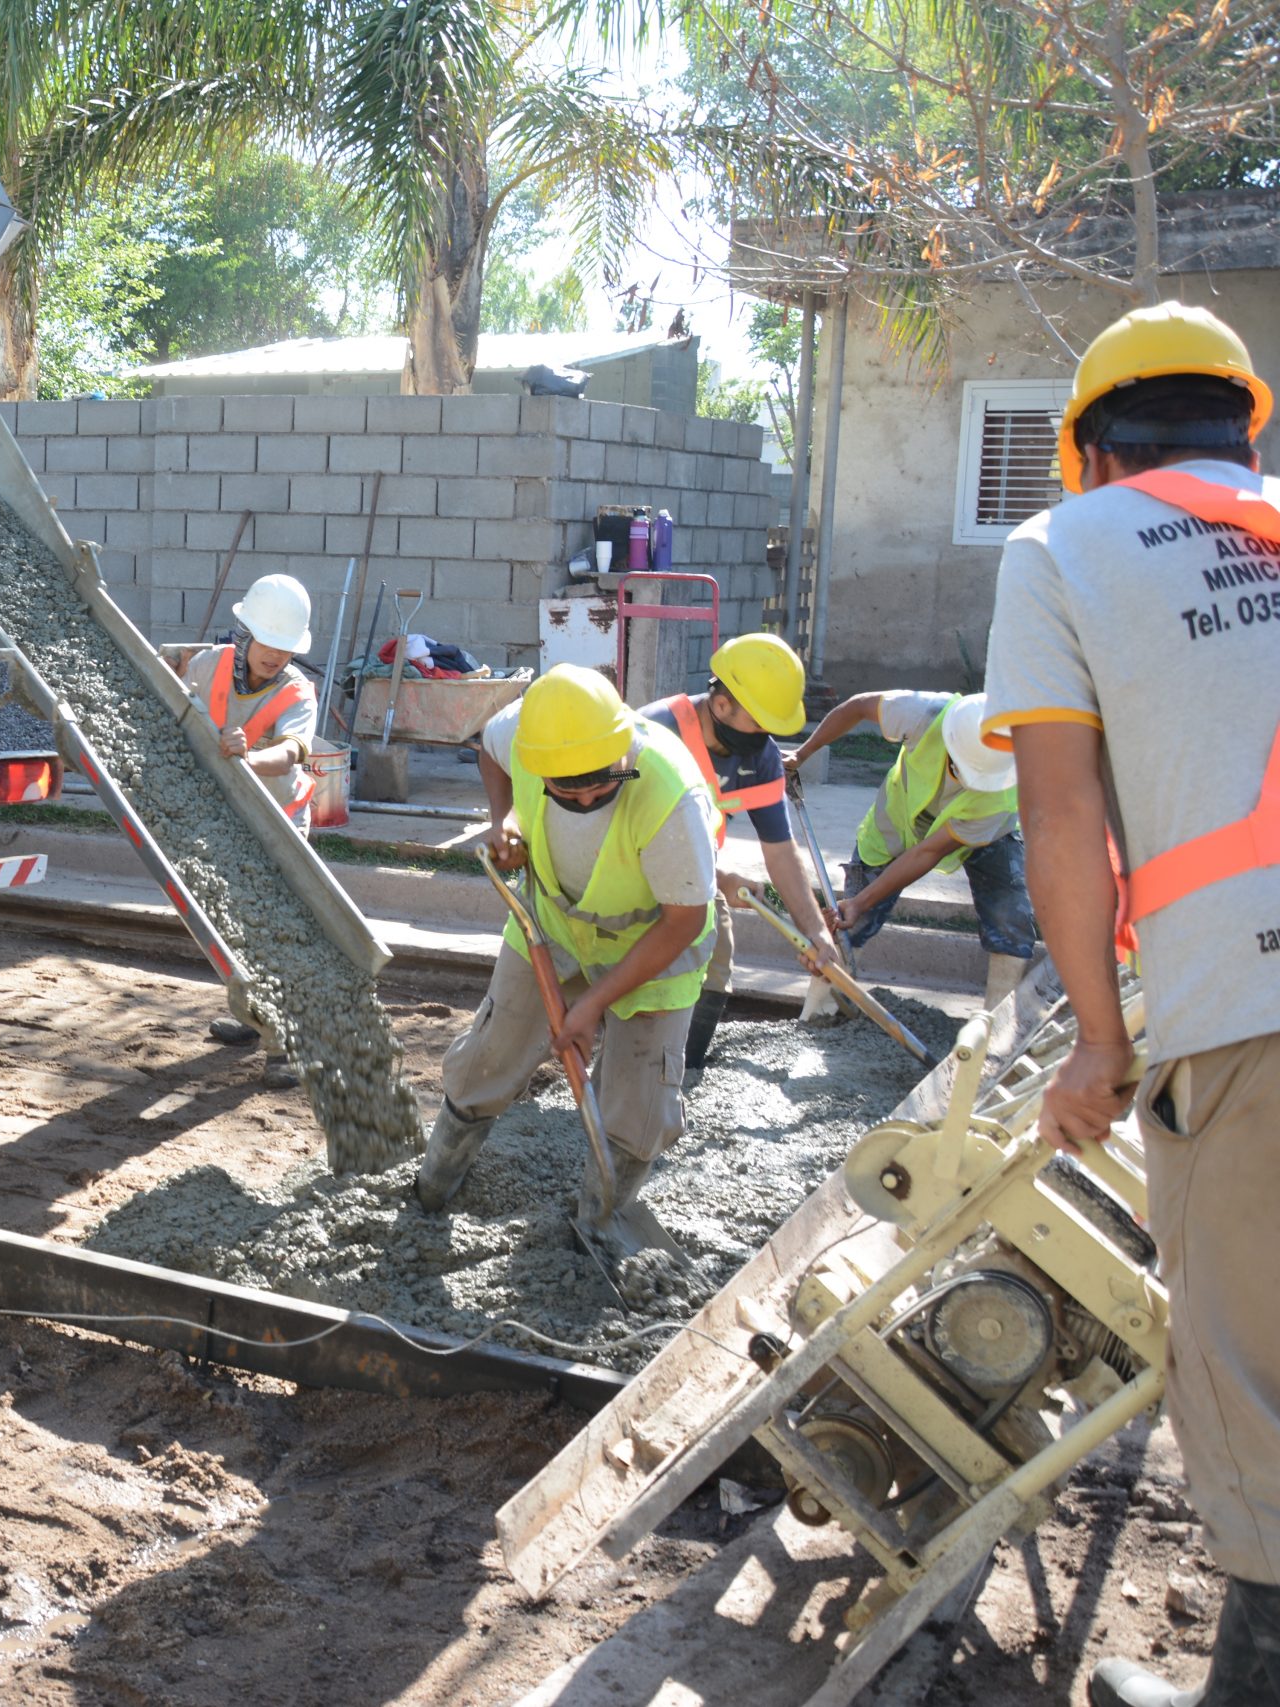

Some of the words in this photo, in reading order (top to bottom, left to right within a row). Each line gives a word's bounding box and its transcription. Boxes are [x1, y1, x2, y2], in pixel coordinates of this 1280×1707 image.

[1215, 536, 1280, 560] ALQU
[1202, 561, 1280, 592] MINIC
[1181, 603, 1231, 640] Tel.
[1255, 928, 1280, 953] za
